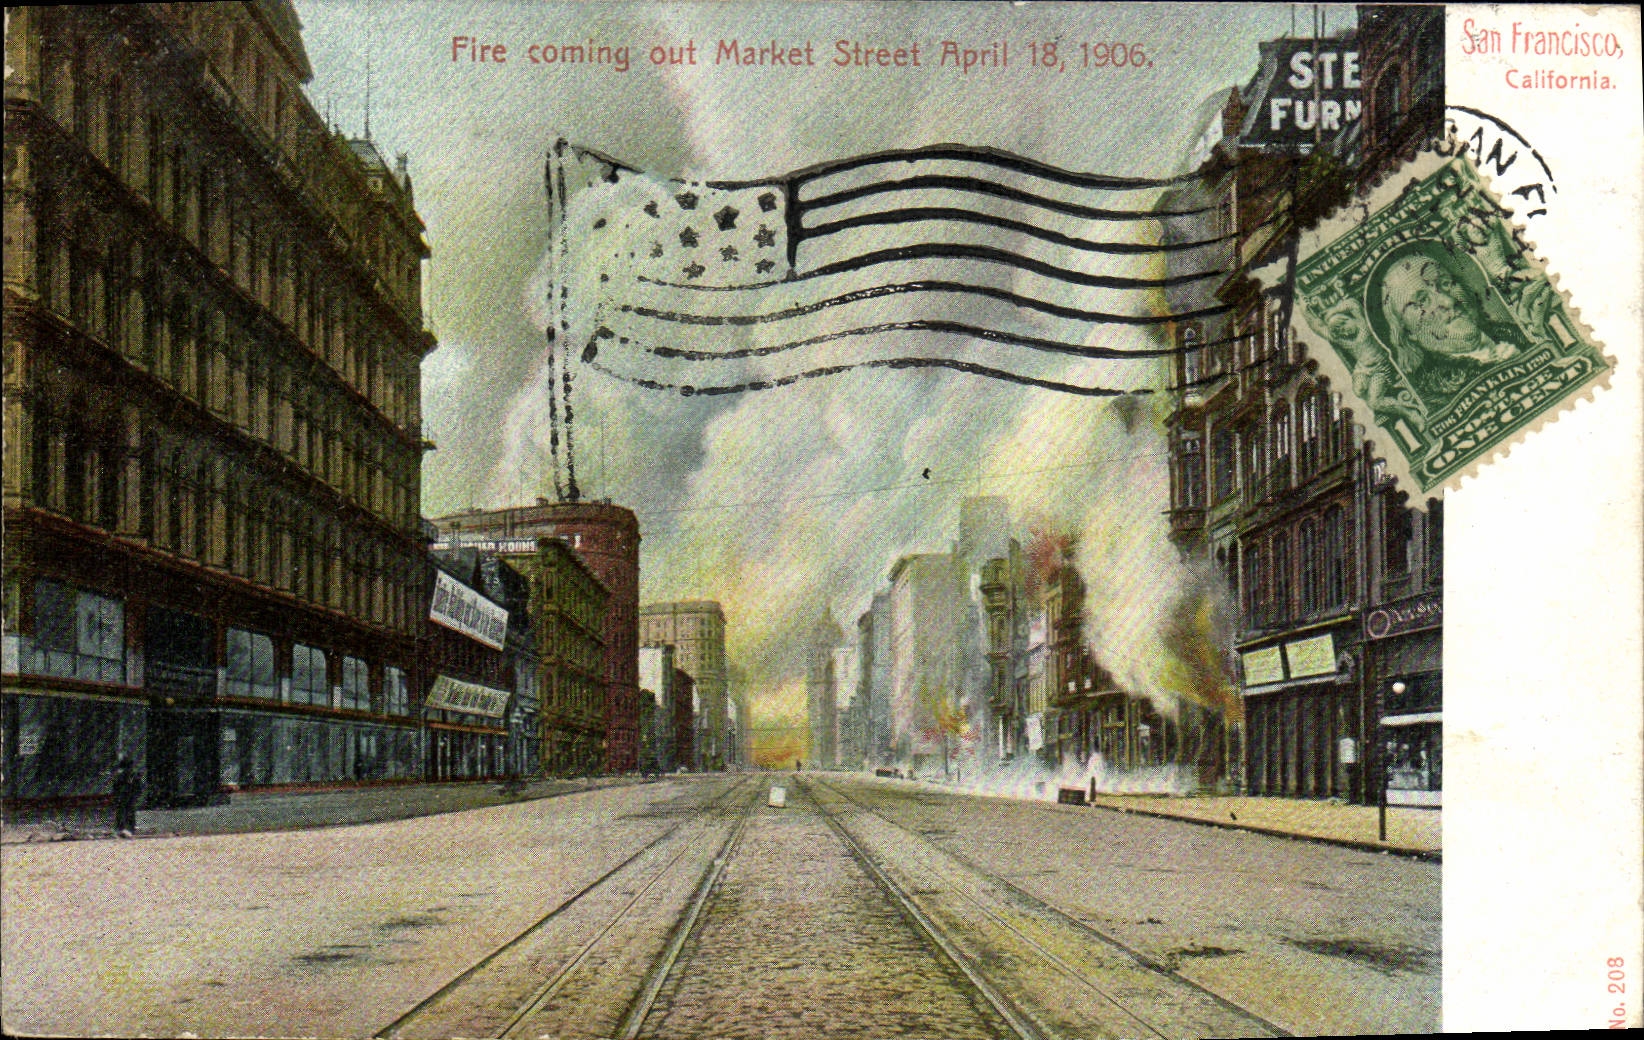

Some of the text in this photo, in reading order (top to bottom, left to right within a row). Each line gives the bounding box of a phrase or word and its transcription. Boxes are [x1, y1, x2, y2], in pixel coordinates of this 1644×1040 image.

[1299, 237, 1367, 285] UNITED
[1361, 190, 1435, 243] STATES
[1428, 361, 1587, 472] ONE CENT
[1444, 367, 1555, 445] POSTAGE
[1453, 363, 1527, 418] FRANKLIN
